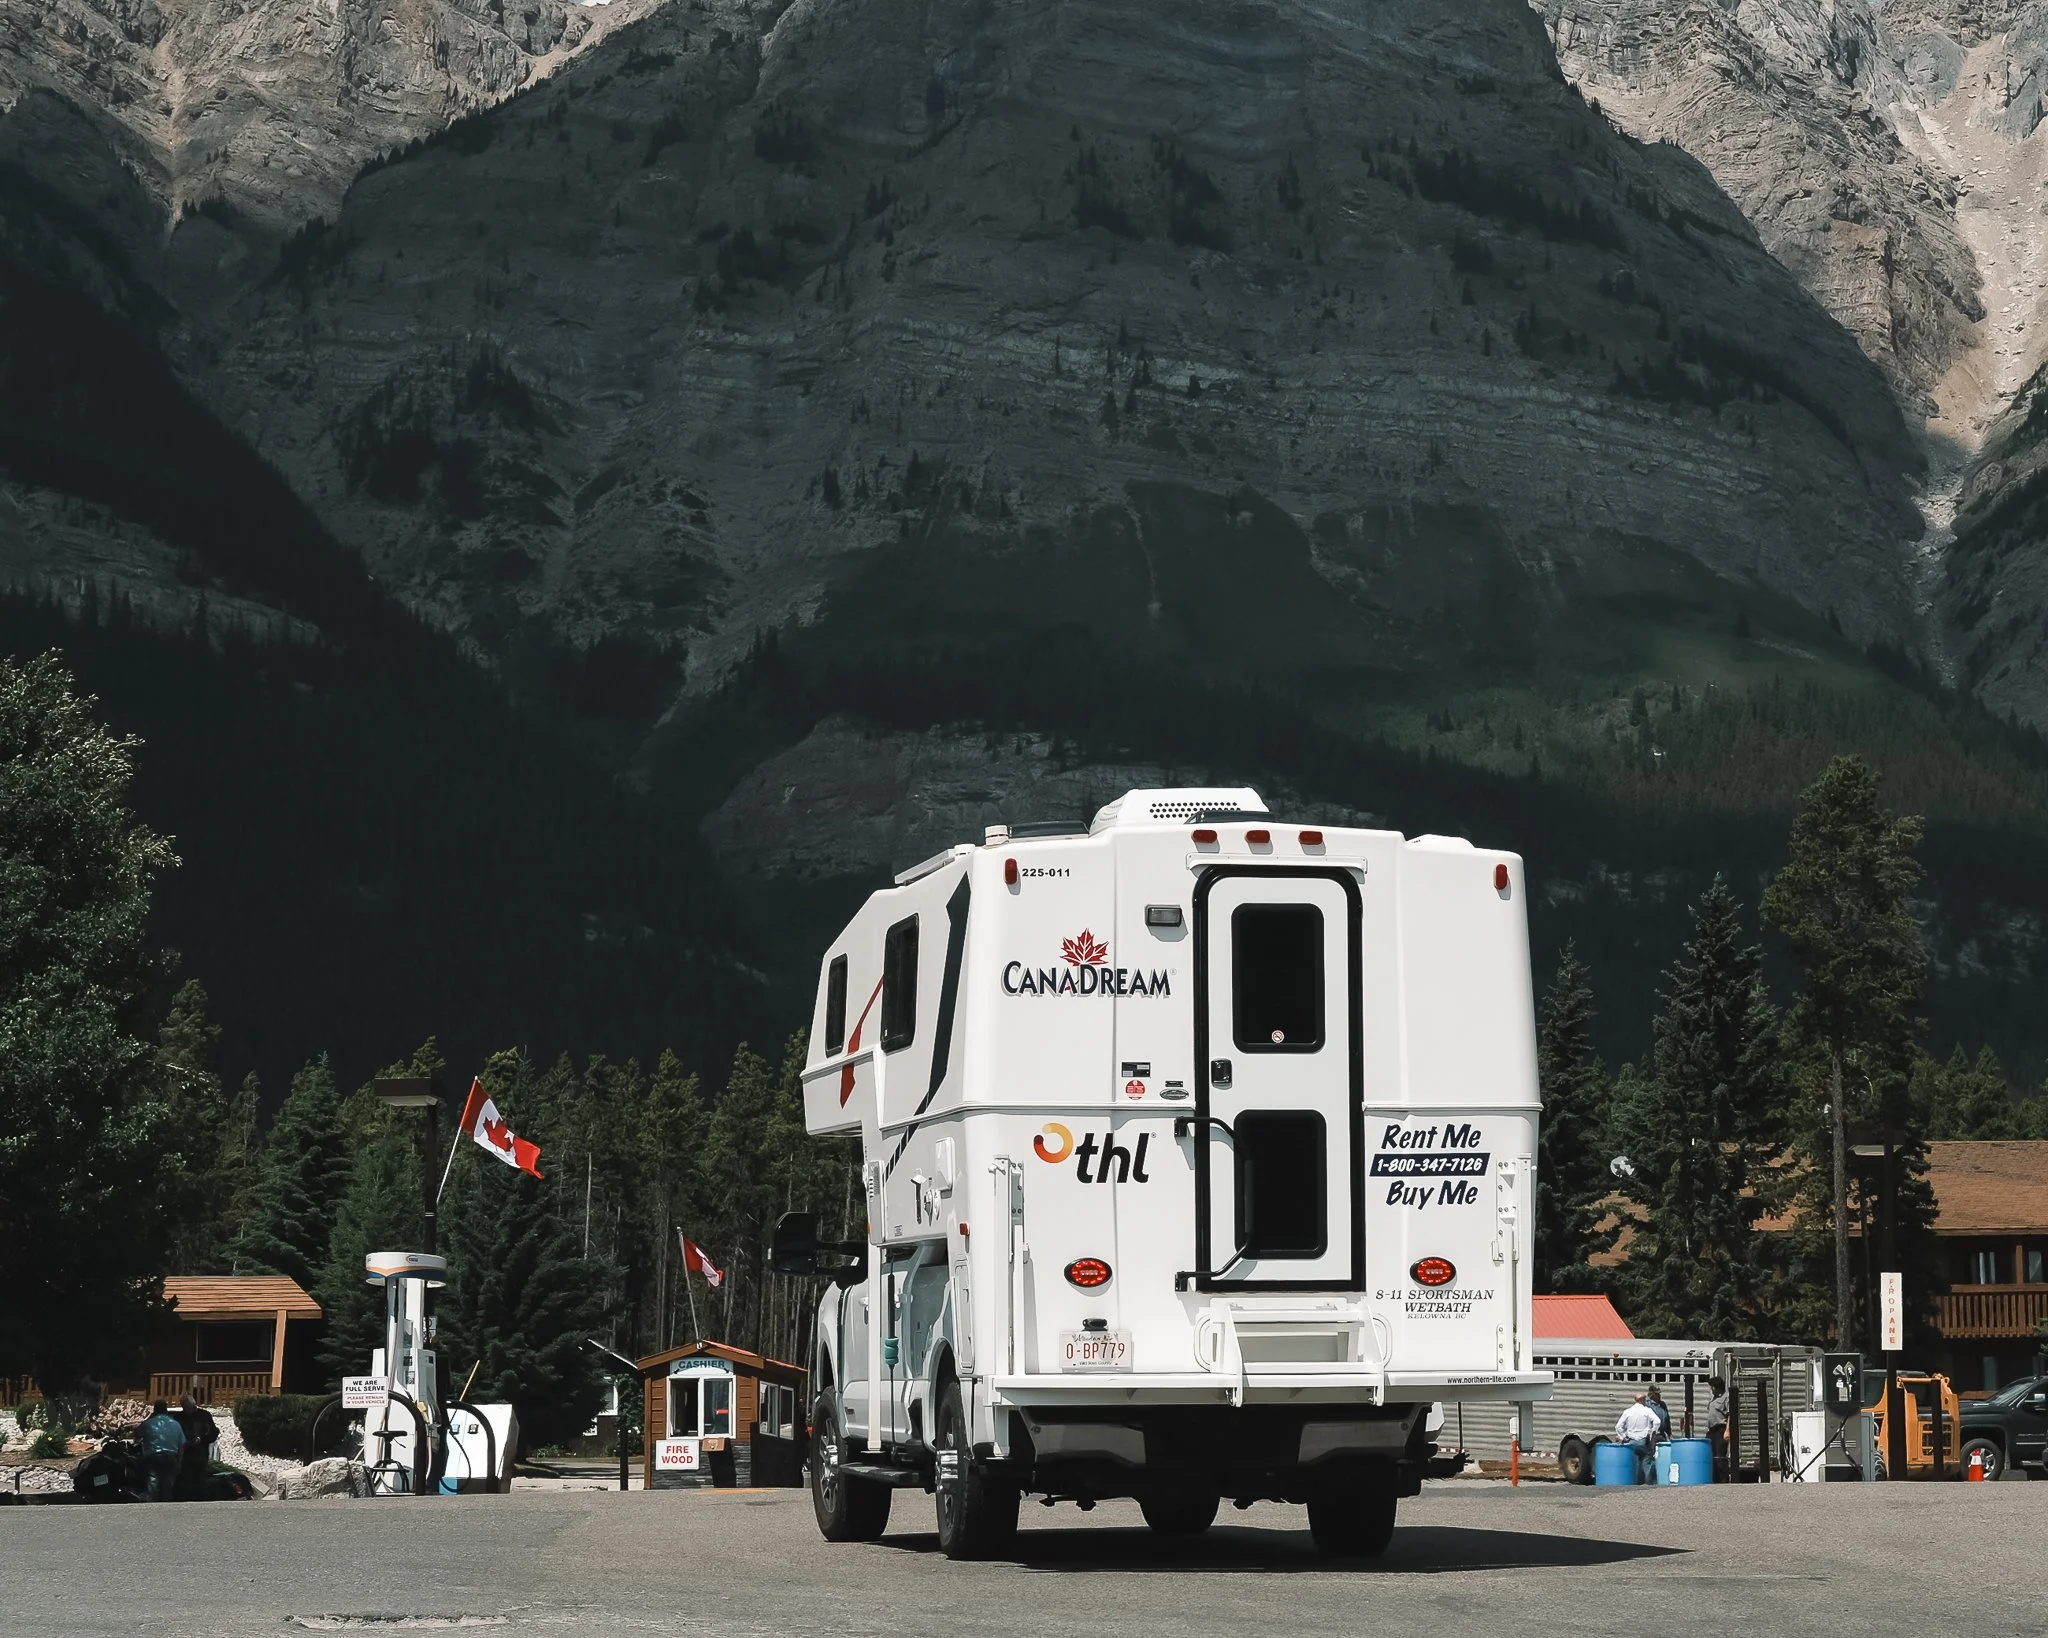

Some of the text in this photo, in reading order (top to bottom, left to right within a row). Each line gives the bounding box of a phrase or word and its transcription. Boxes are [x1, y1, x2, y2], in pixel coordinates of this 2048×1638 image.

[1021, 867, 1070, 878] 225-011
[1380, 1123, 1482, 1150] Rent Me
[1074, 1132, 1150, 1184] thl
[1376, 1157, 1483, 1172] 1-800-347-7126
[1385, 1179, 1479, 1211] Buy Me
[1407, 1289, 1495, 1300] SPORTSMAN
[1404, 1302, 1473, 1313] WETBATH
[1888, 1278, 1896, 1344] PROPANE
[677, 1359, 726, 1370] CASHIER
[1446, 1375, 1517, 1384] www.northern-lite.com
[665, 1445, 690, 1455] FIRE
[661, 1455, 694, 1464] WOOD
